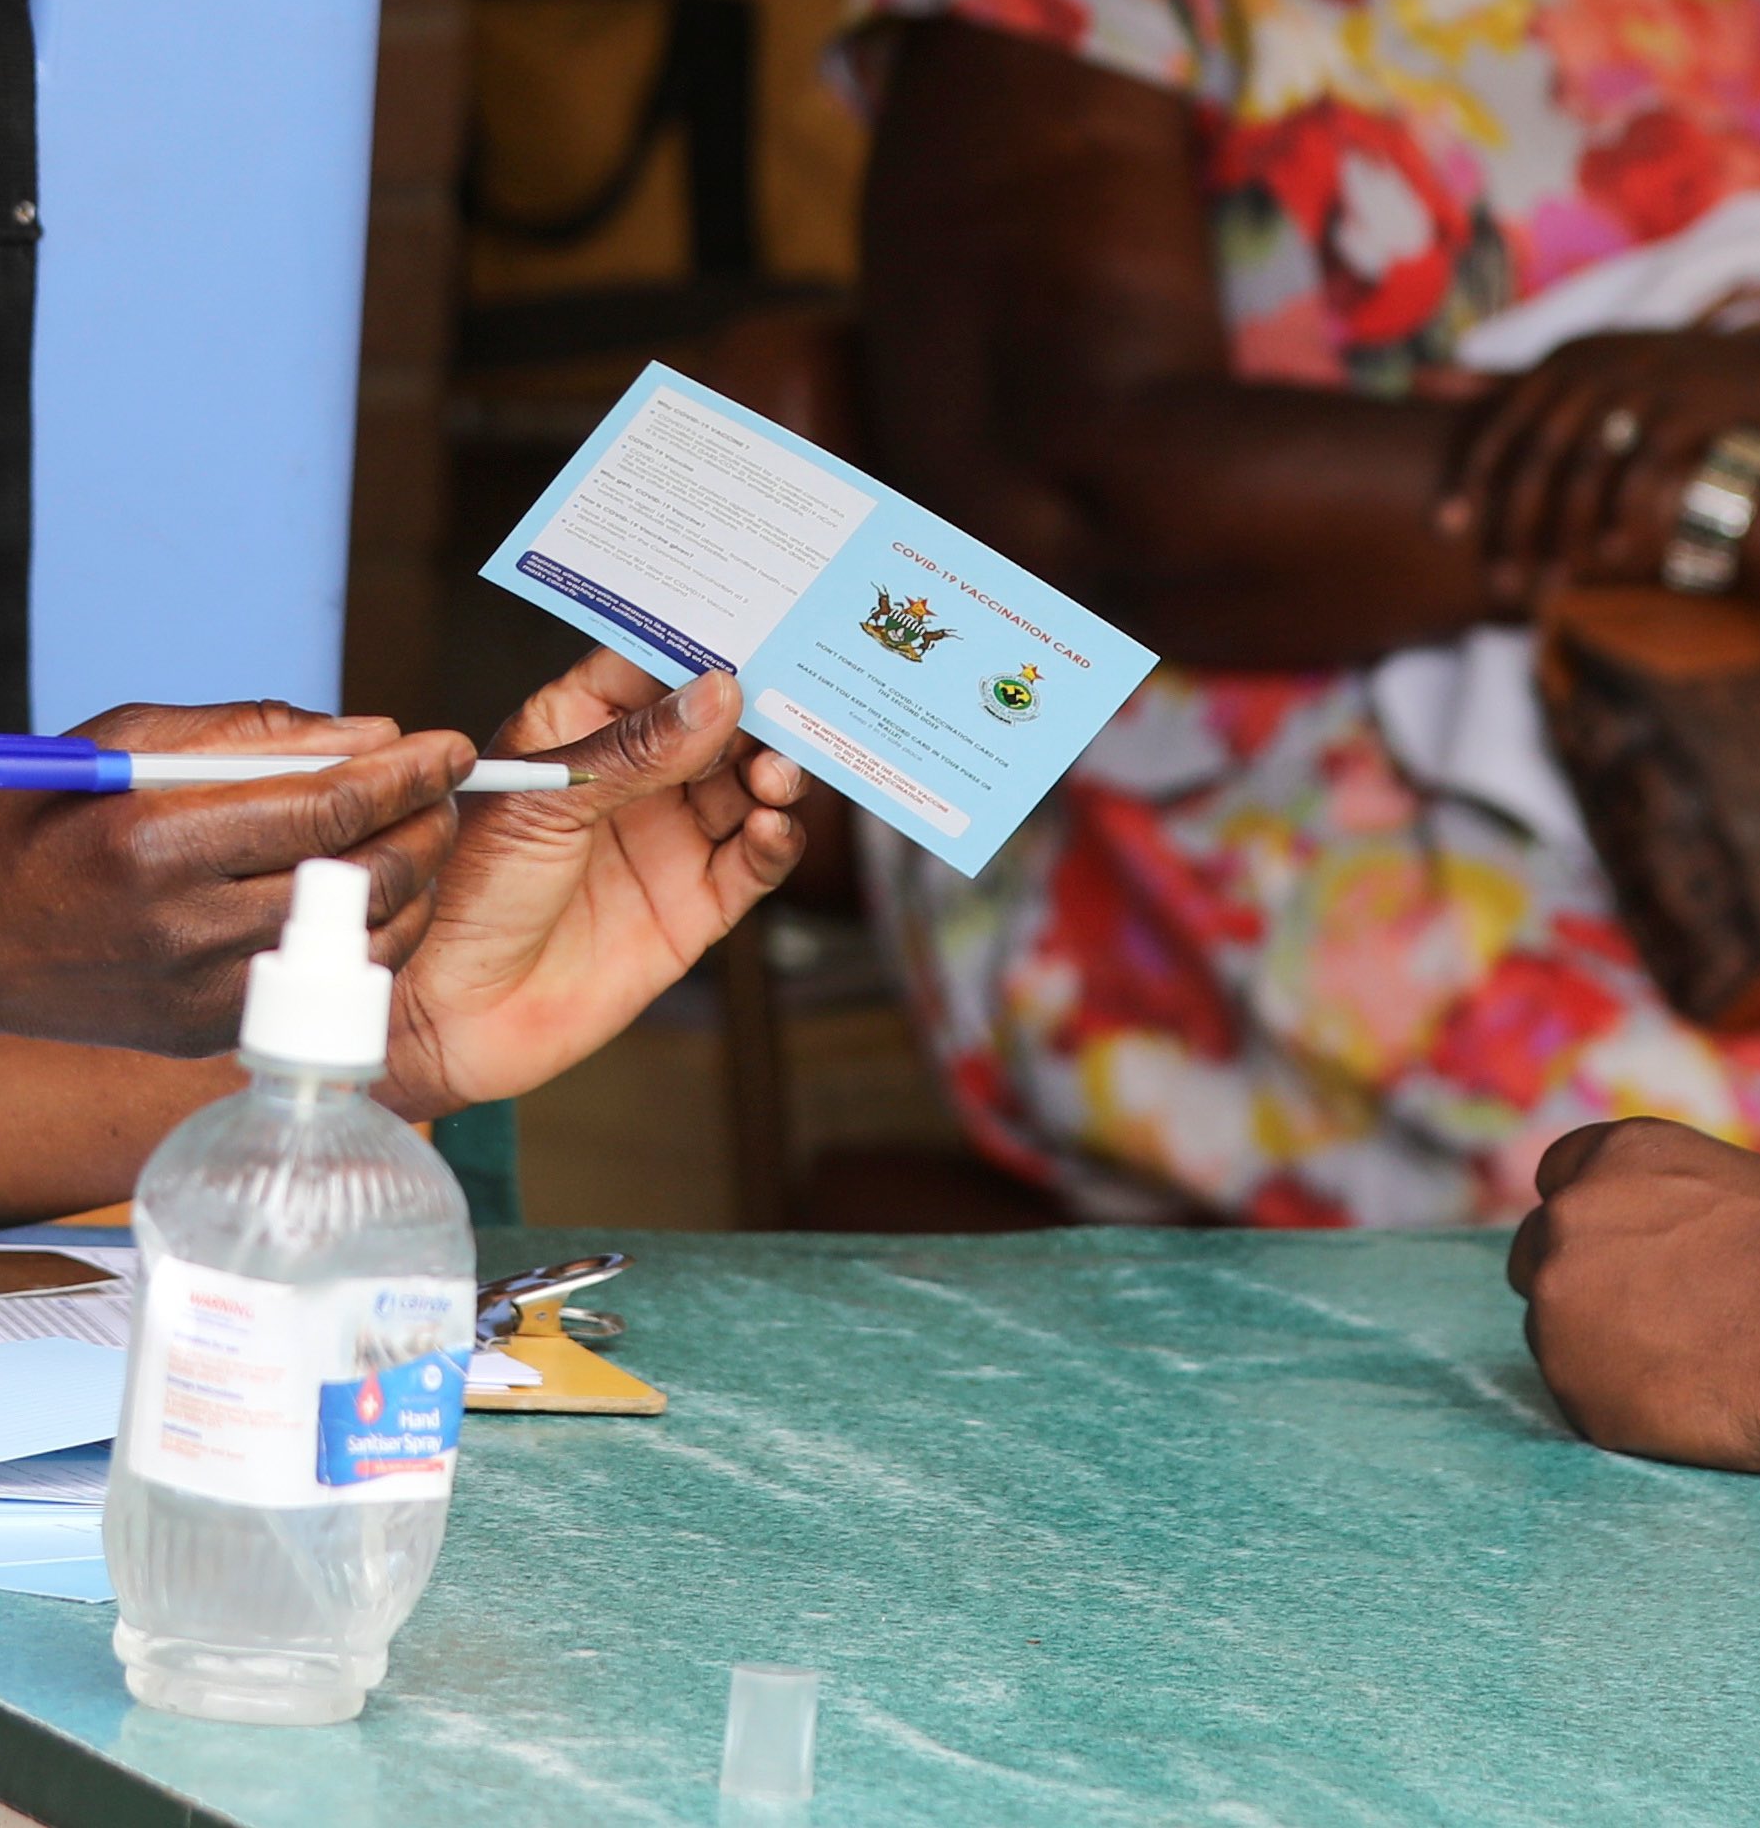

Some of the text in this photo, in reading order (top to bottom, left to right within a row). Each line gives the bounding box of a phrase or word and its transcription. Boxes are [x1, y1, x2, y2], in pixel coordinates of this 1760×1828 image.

[708, 425, 744, 447] VACCINE
[890, 540, 1092, 669] COVID-19 VACCINATION CARD
[795, 662, 992, 791] MAKE SURE YOU KEEP THIS RECORD CARD IN YOUR PURSE OR
[836, 655, 864, 674] FORGET
[866, 673, 887, 688] YOUR
[887, 686, 923, 712] COVID-19
[924, 710, 974, 745] VACCINATION
[973, 742, 995, 759] CARD
[994, 756, 1010, 768] FOR
[877, 688, 939, 731] THE SECOND DOSE
[783, 703, 949, 813] FOR MORE INFORMATION ON THE COVID VACCINE
[800, 721, 924, 805] OR WHAT TO DO AFTER VACCINATION
[833, 750, 852, 765] CALL
[347, 1433, 443, 1454] Sanitiser Spray
[401, 1409, 441, 1428] Hand
